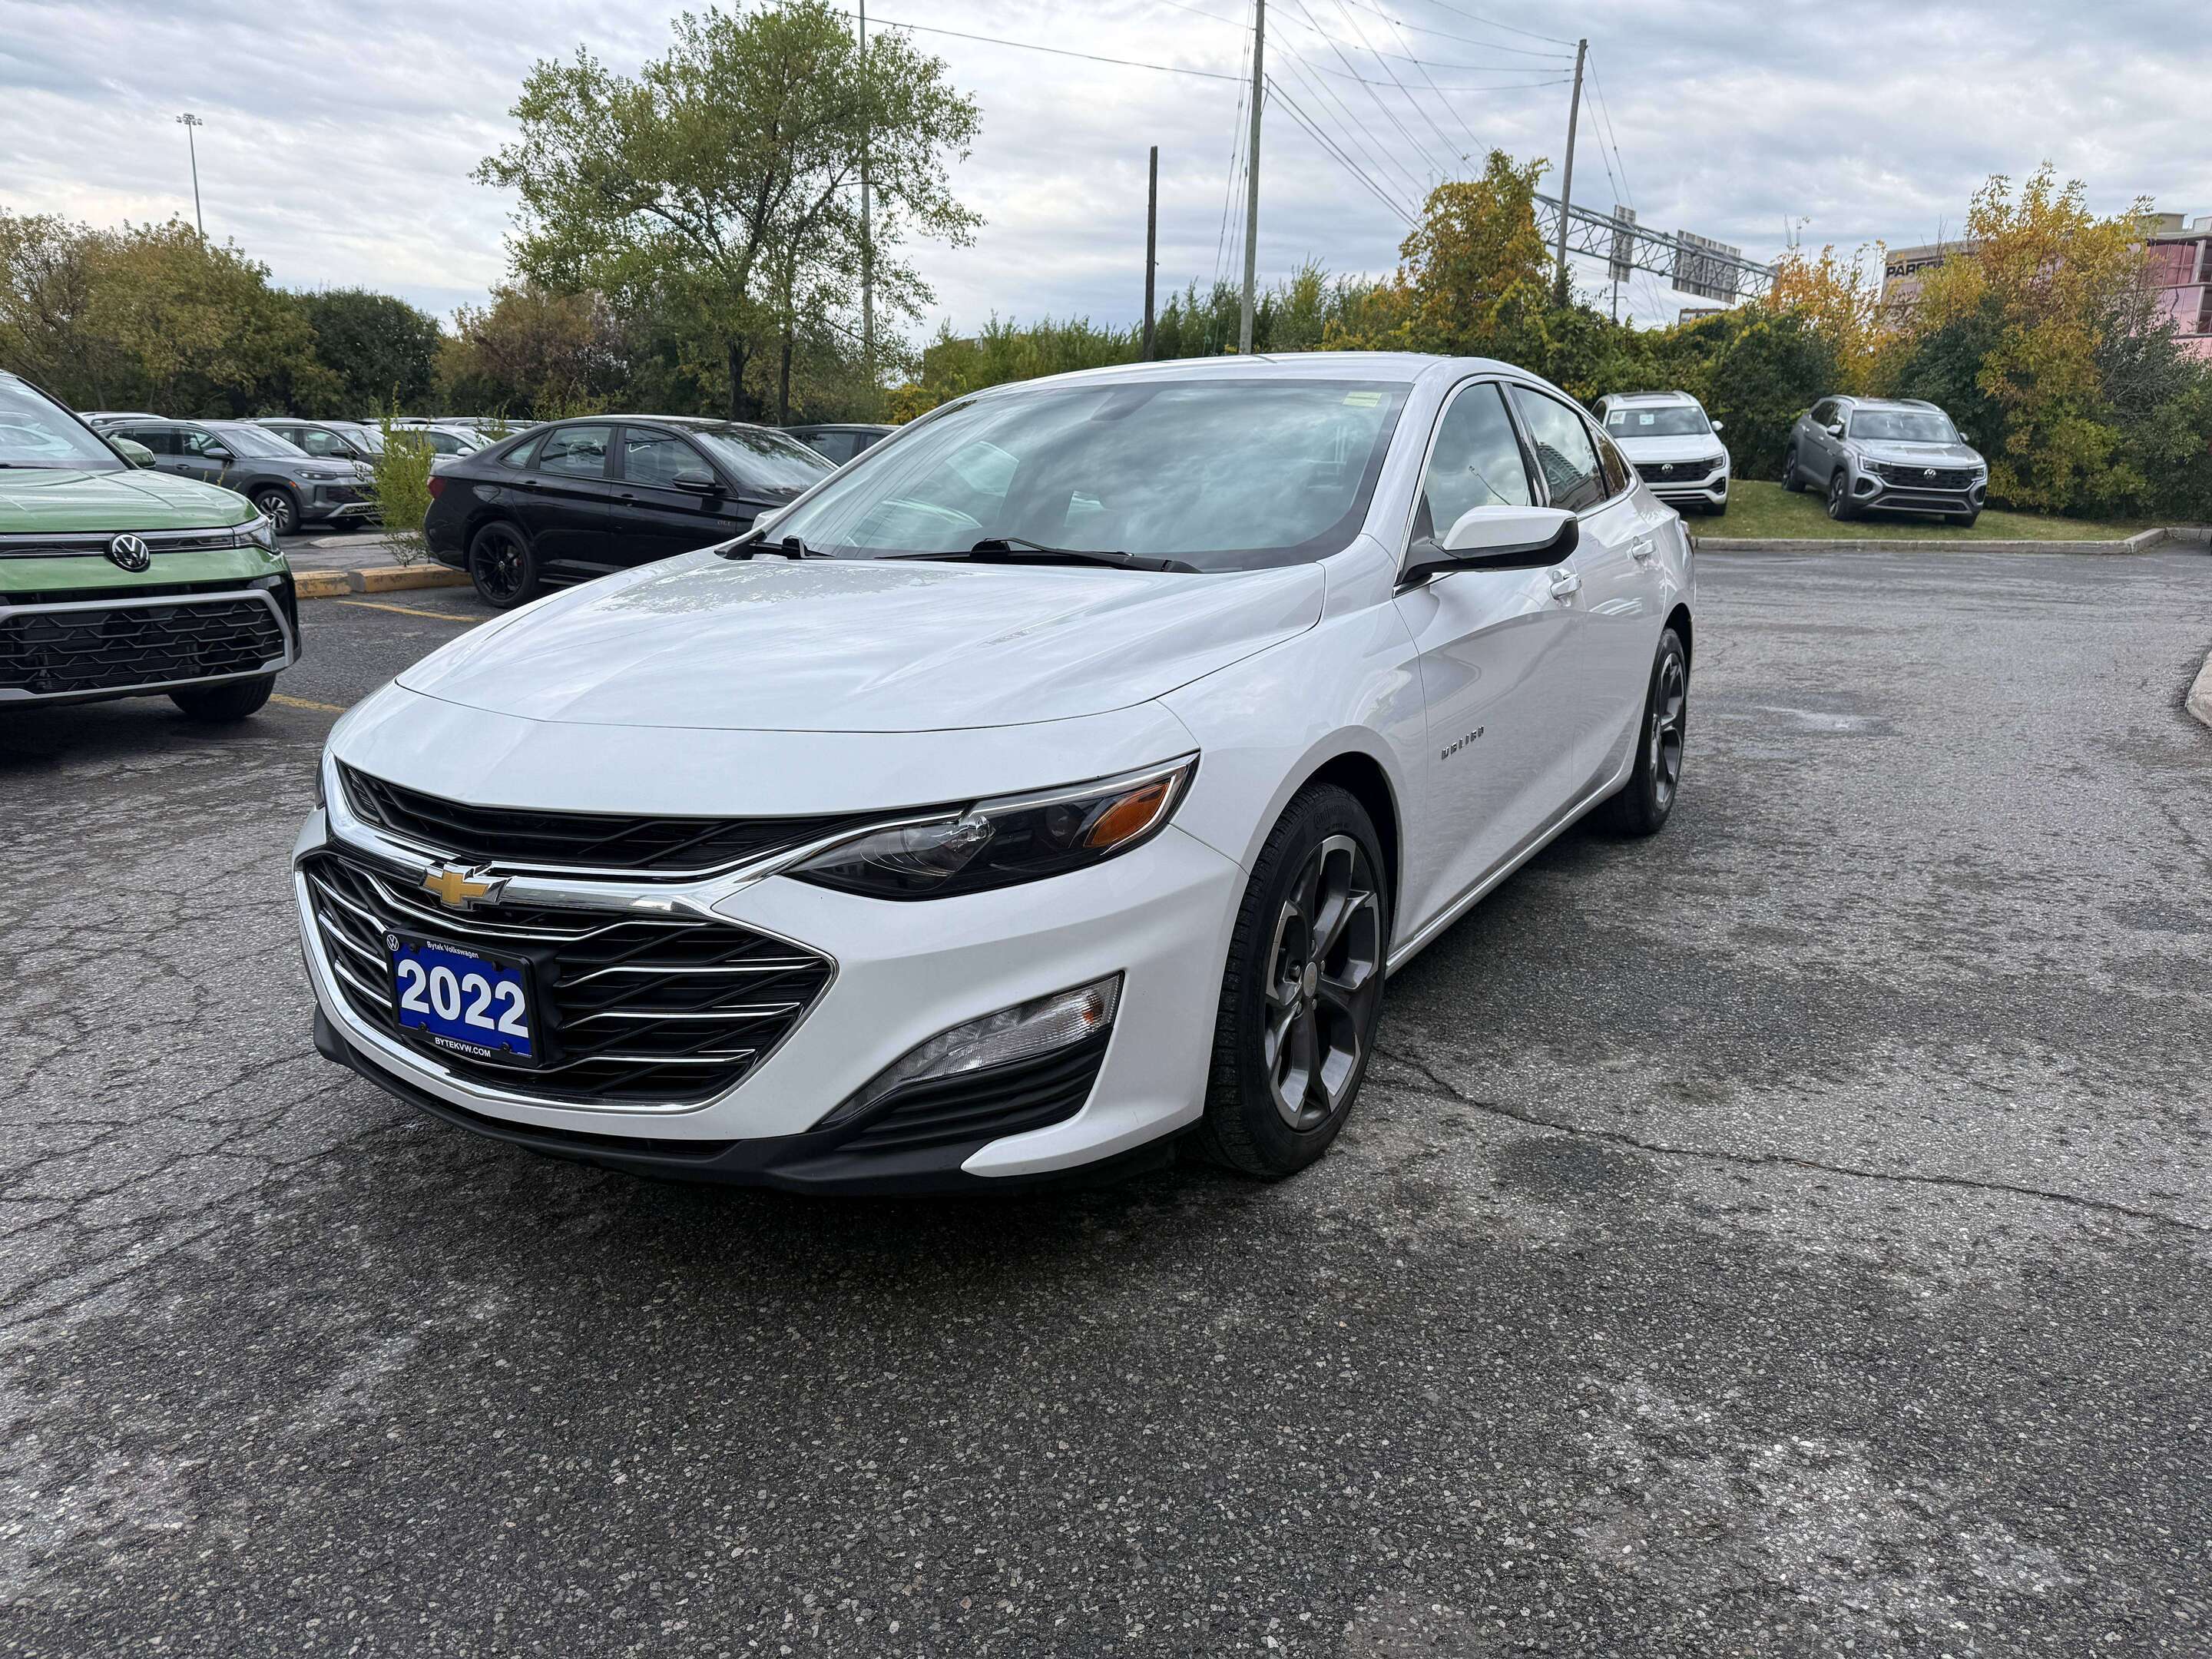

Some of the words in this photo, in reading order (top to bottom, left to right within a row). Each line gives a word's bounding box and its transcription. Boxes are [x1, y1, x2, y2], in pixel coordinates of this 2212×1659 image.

[427, 941, 444, 951] Bytek
[444, 945, 479, 959] Volkswagen
[398, 959, 529, 1038] 2022
[435, 1038, 492, 1058] BYTEKVW.COM
